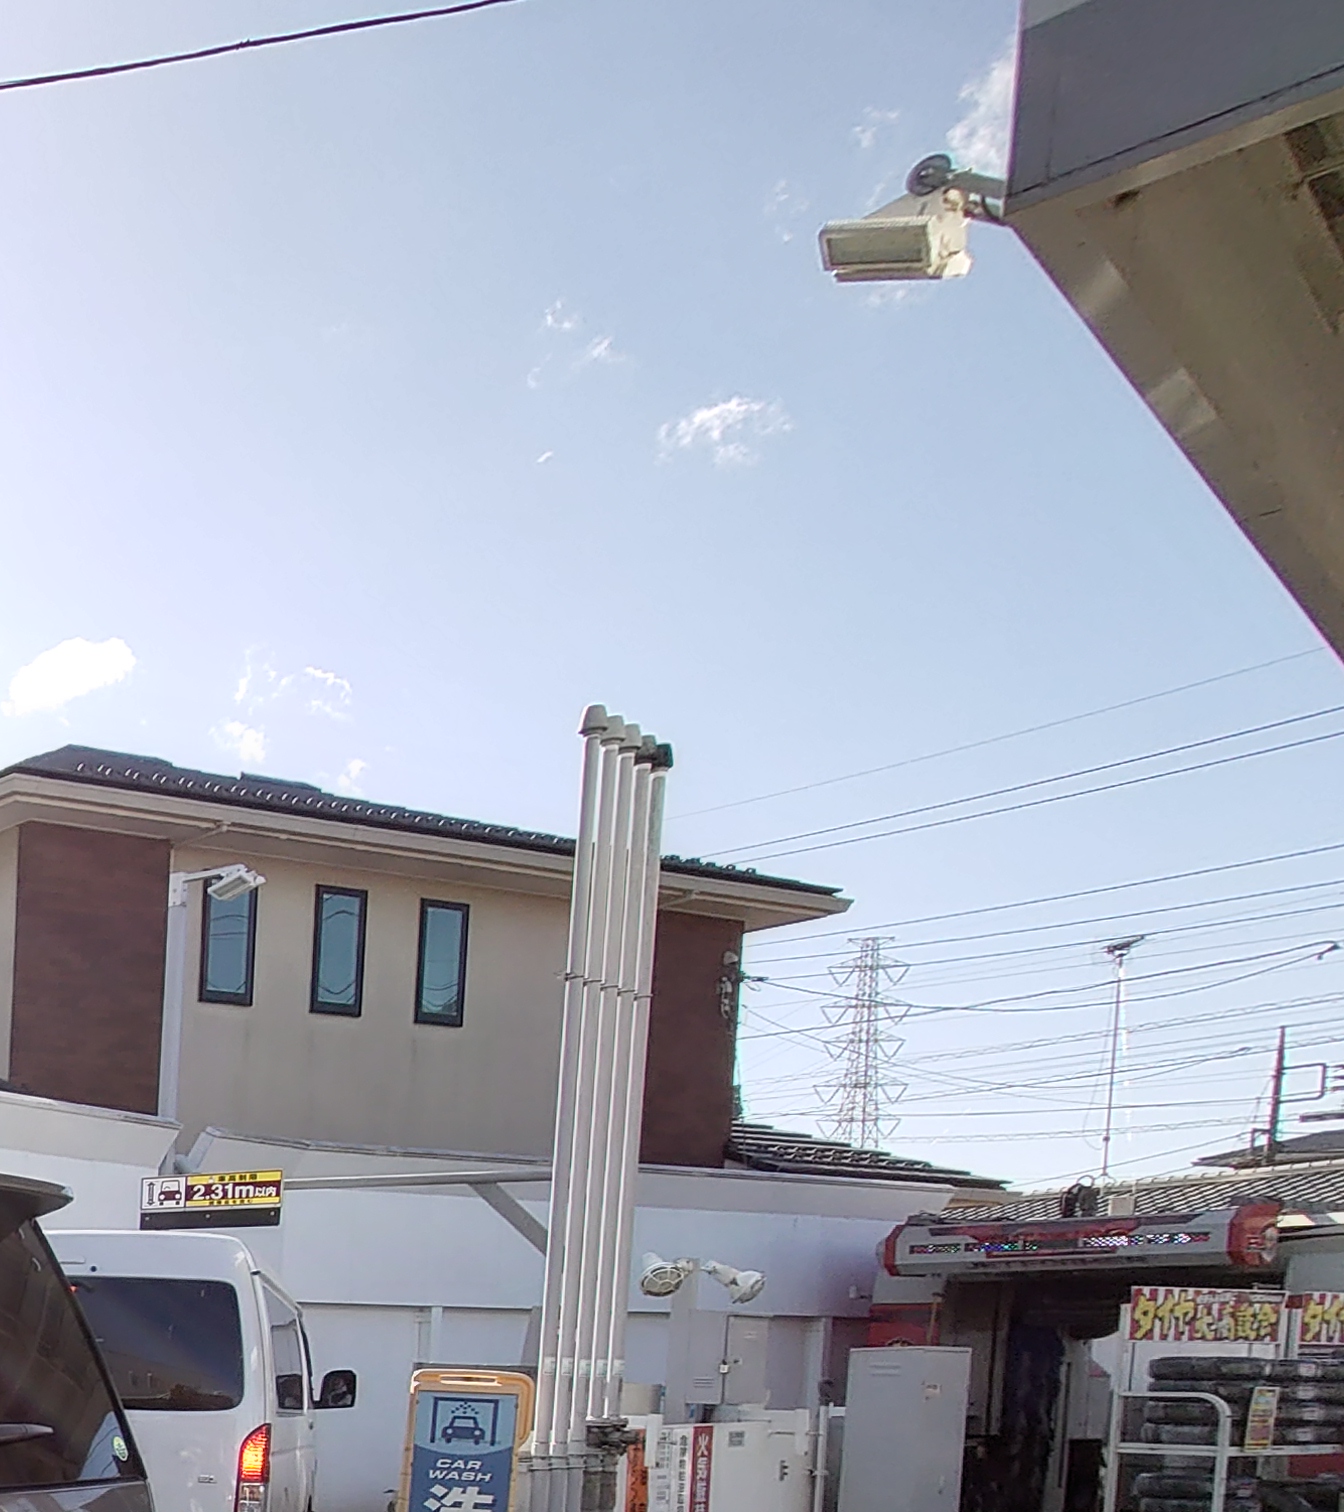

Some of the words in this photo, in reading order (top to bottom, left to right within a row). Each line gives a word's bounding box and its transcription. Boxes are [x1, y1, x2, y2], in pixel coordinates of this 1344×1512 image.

[1302, 1298, 1344, 1341] タイ
[436, 1458, 482, 1470] CAR
[429, 1469, 492, 1482] WASH
